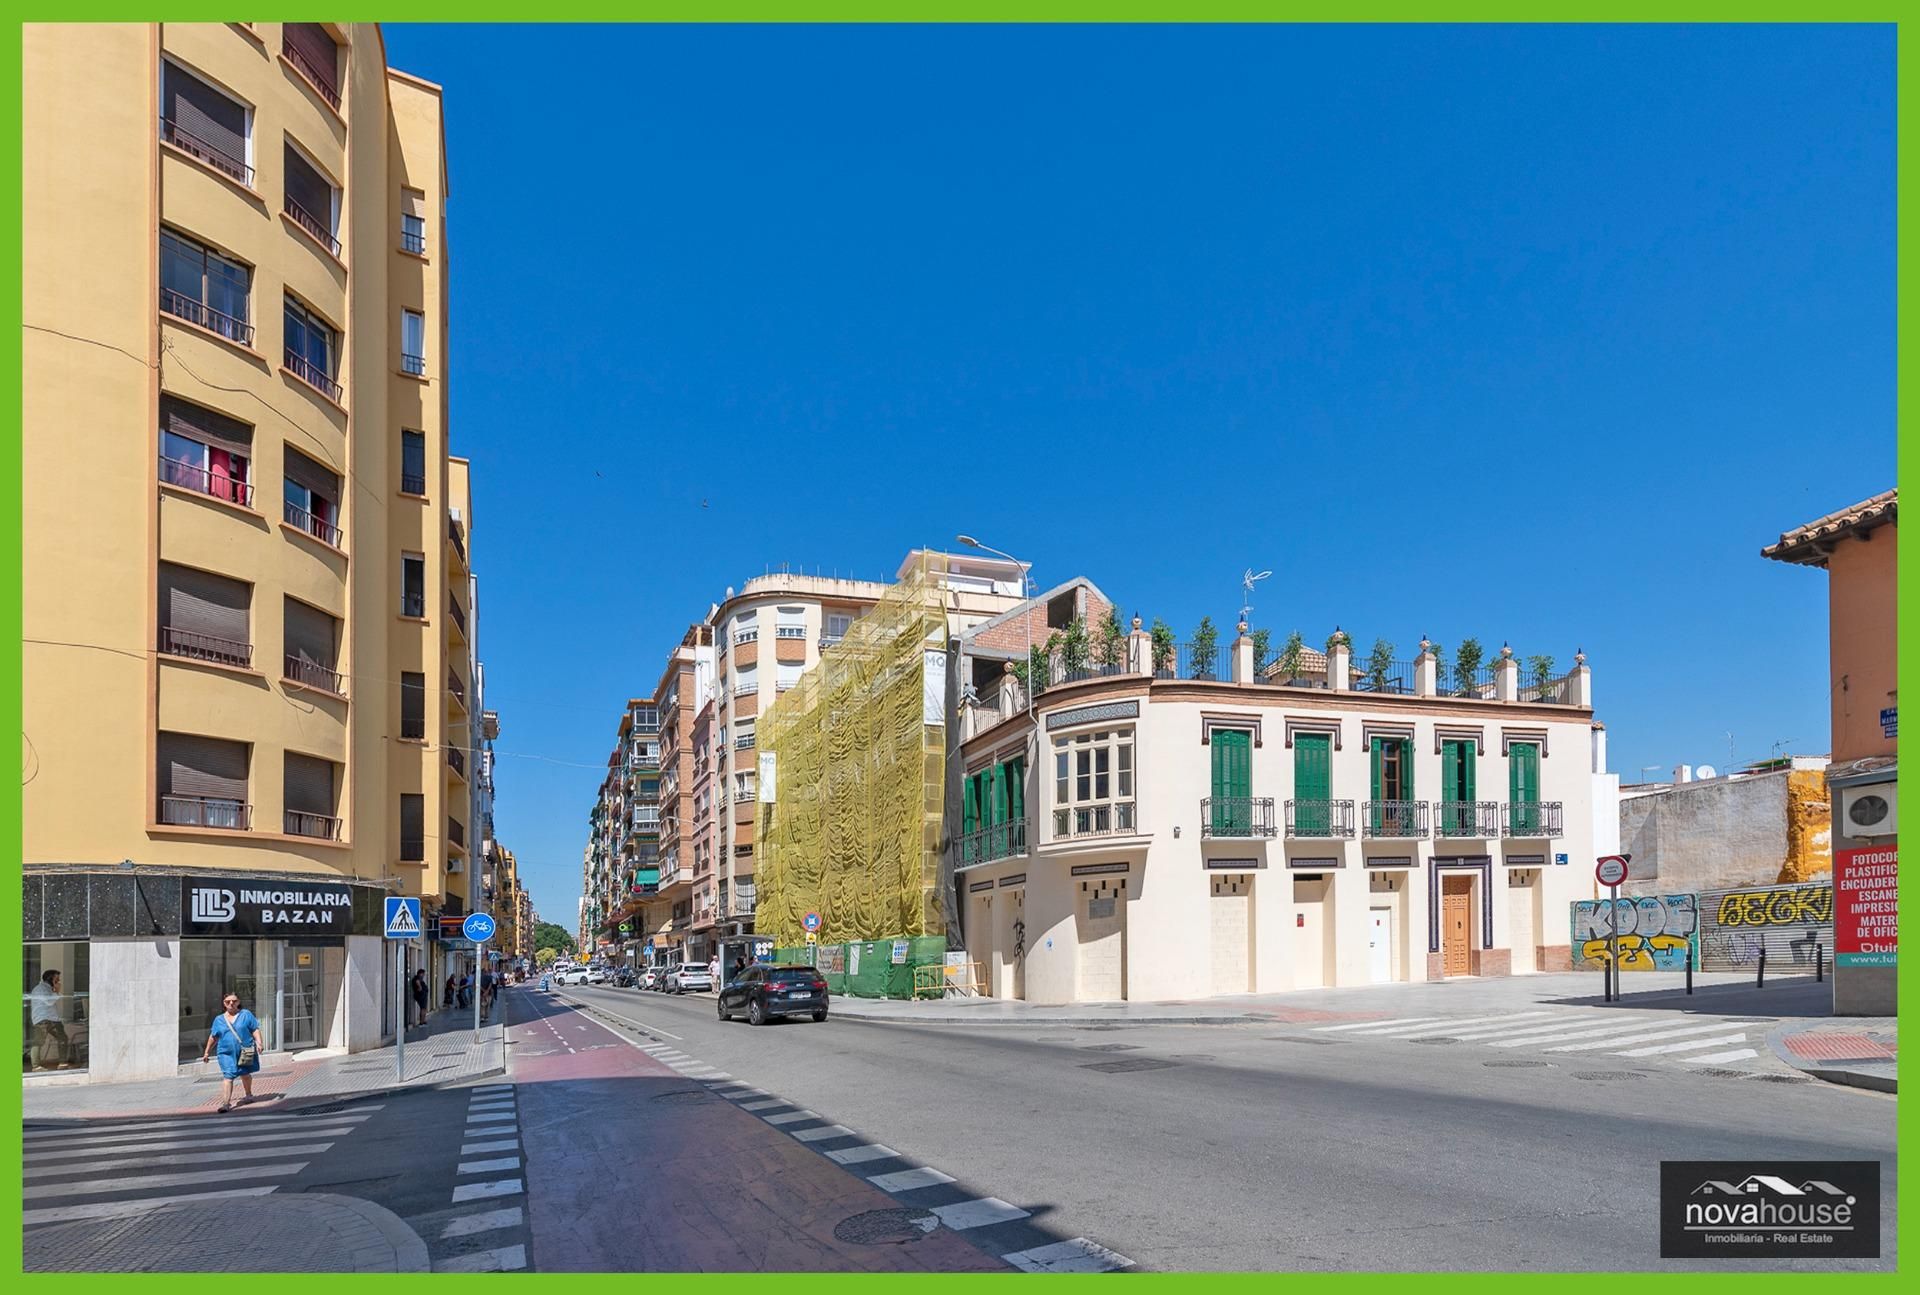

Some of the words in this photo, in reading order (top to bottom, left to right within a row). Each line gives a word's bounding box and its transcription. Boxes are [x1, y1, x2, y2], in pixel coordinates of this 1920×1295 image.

[1840, 877, 1898, 890] ENCUADER
[240, 890, 351, 906] INMOBILIARIA
[262, 910, 333, 924] BAZAN
[1857, 928, 1870, 938] DE
